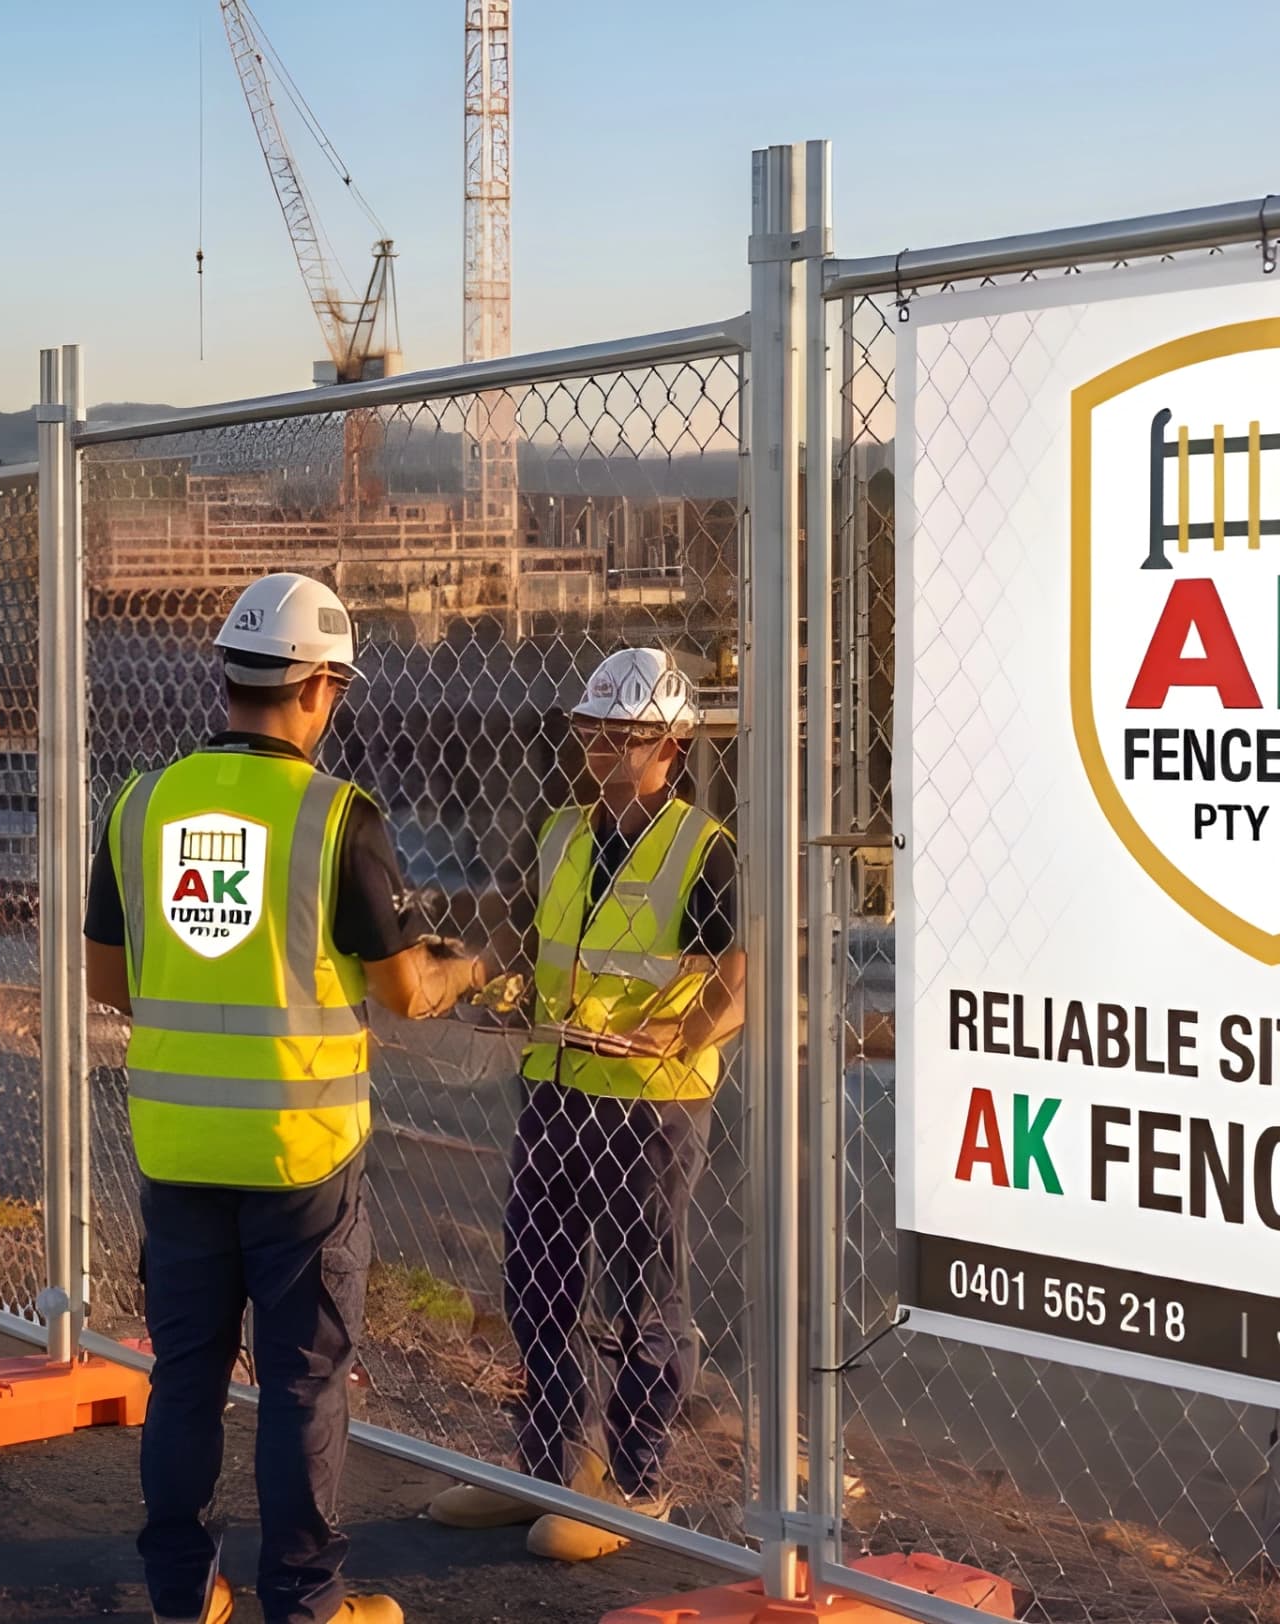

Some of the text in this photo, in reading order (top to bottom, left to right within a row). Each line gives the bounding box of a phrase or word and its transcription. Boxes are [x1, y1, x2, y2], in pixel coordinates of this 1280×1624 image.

[1193, 803, 1270, 842] PTY
[172, 868, 250, 905] AK
[948, 987, 1200, 1079] RELIABLE
[953, 1086, 1066, 1197] AK
[948, 1259, 1187, 1343] 0401 565 218
